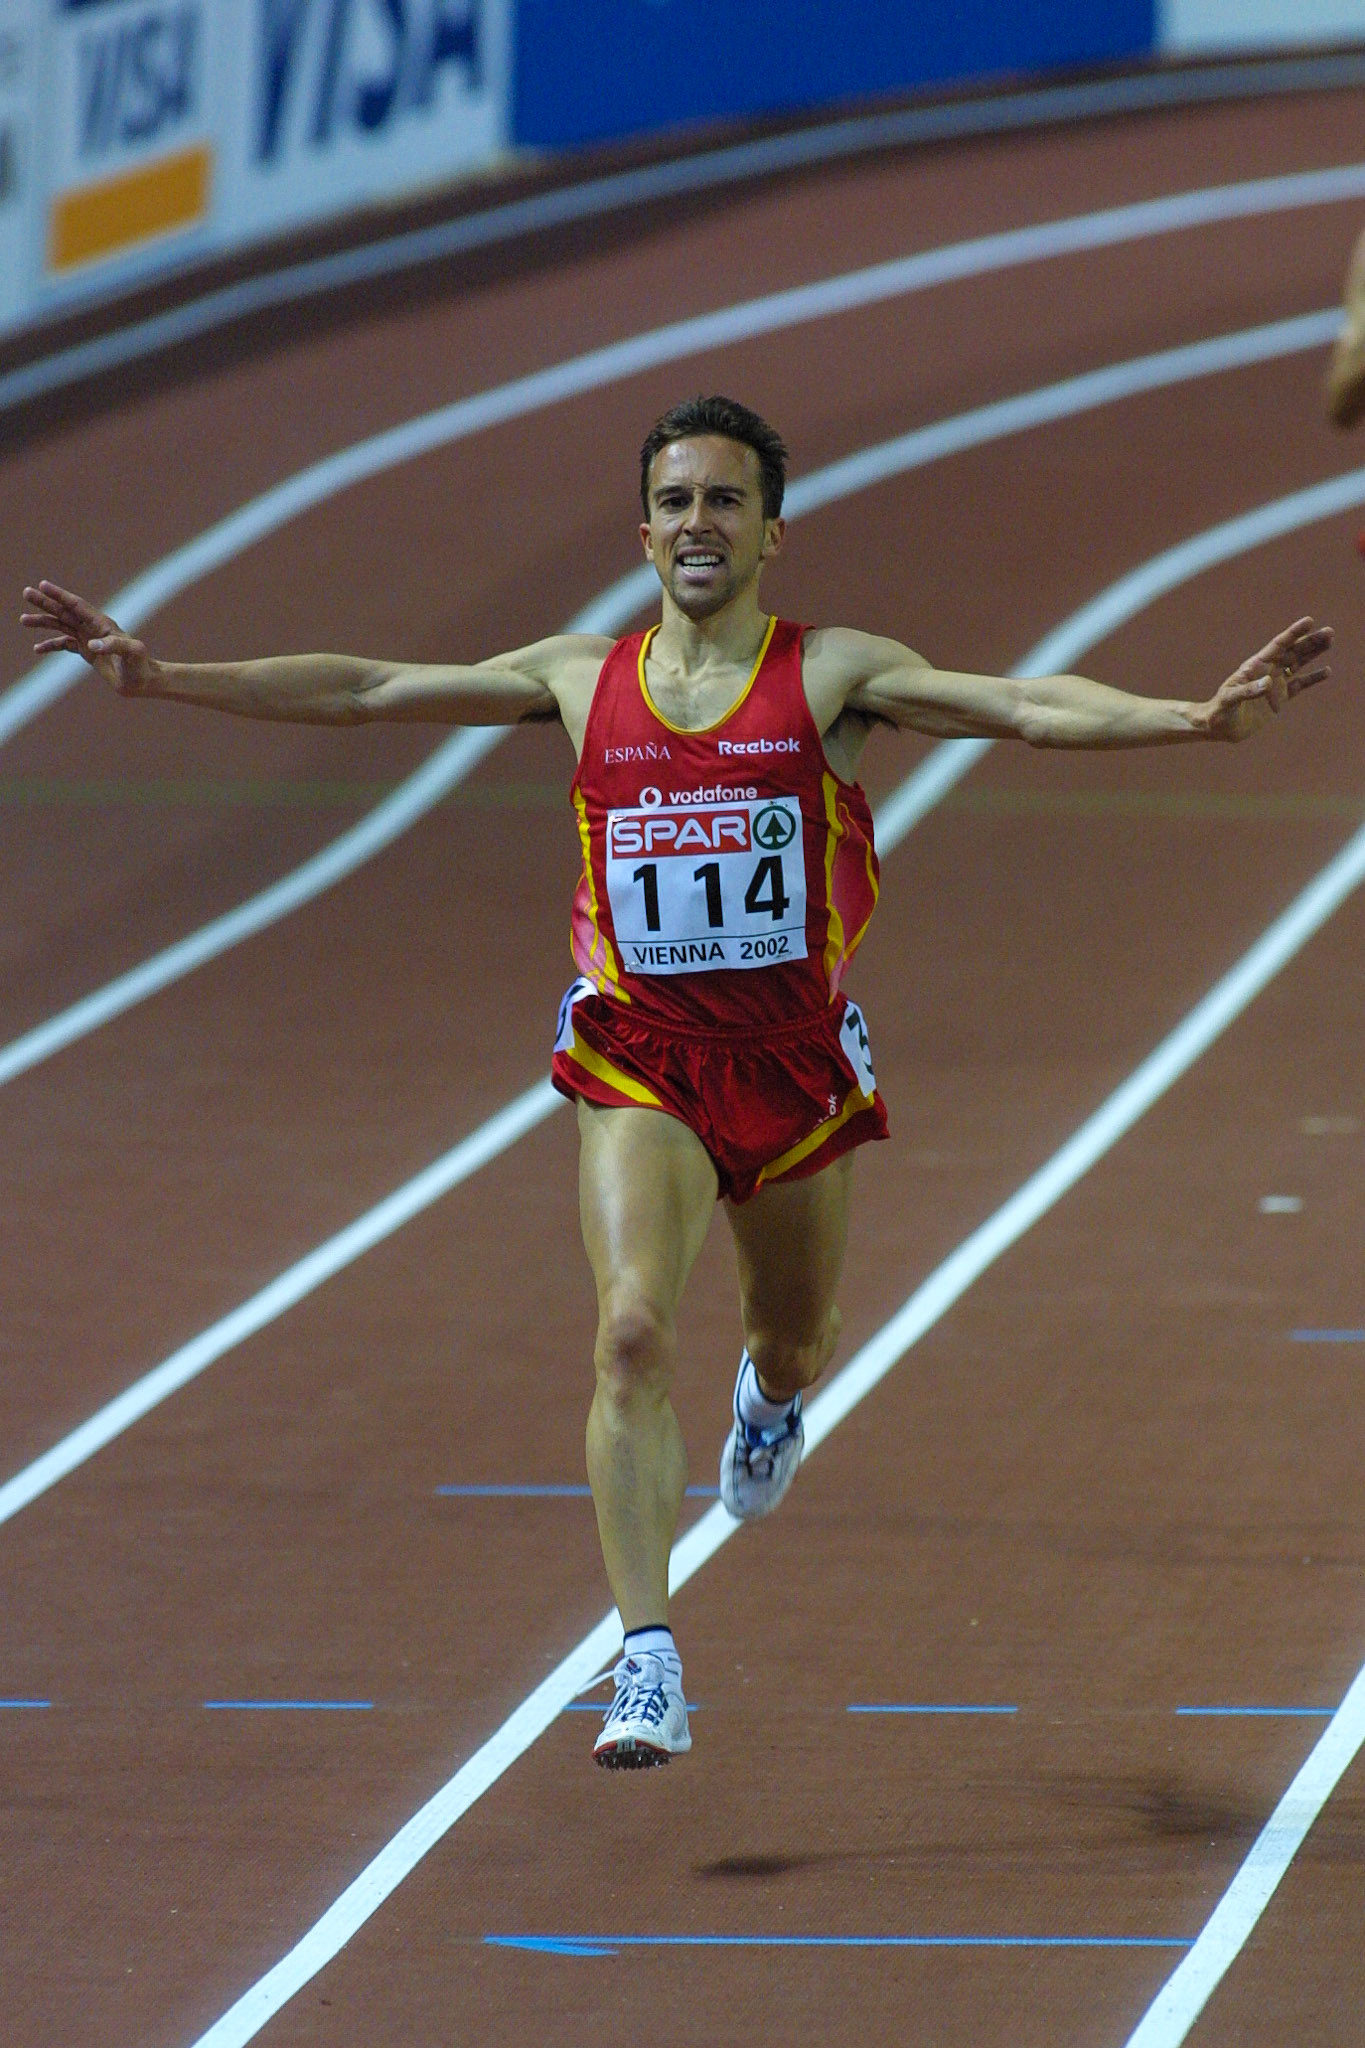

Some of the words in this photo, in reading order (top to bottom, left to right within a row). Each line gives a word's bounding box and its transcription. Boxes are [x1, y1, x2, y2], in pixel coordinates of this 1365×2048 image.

[604, 741, 672, 764] ESPAÑA
[717, 737, 801, 756] Reebok
[669, 785, 758, 805] vodafone
[612, 815, 747, 854] SPAR
[632, 855, 790, 932] 114
[632, 942, 725, 966] VIENNA
[740, 935, 790, 960] 2002
